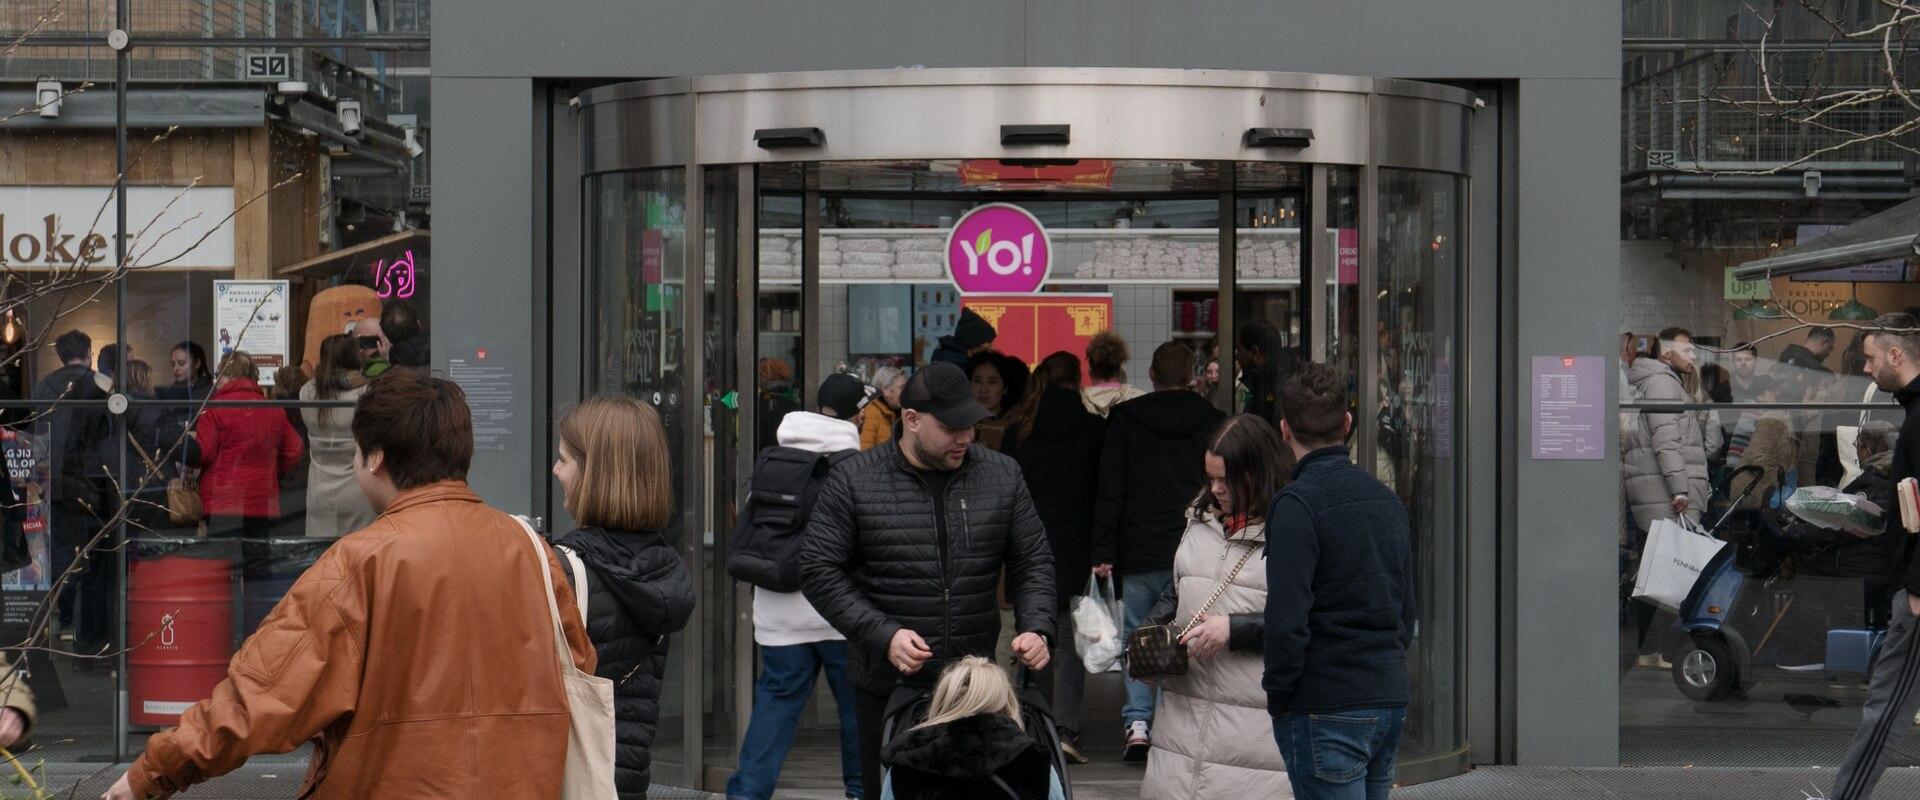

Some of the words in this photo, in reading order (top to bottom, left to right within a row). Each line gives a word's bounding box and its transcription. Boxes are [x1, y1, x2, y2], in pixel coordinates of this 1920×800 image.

[250, 56, 285, 76] 90
[960, 228, 1034, 276] YO!
[1340, 247, 1358, 255] ORDE
[1732, 282, 1757, 294] UP!
[1764, 299, 1845, 316] HOPP
[17, 448, 31, 458] JIJ
[21, 459, 35, 468] OP
[9, 469, 30, 478] OK?
[23, 520, 42, 530] FICIAL
